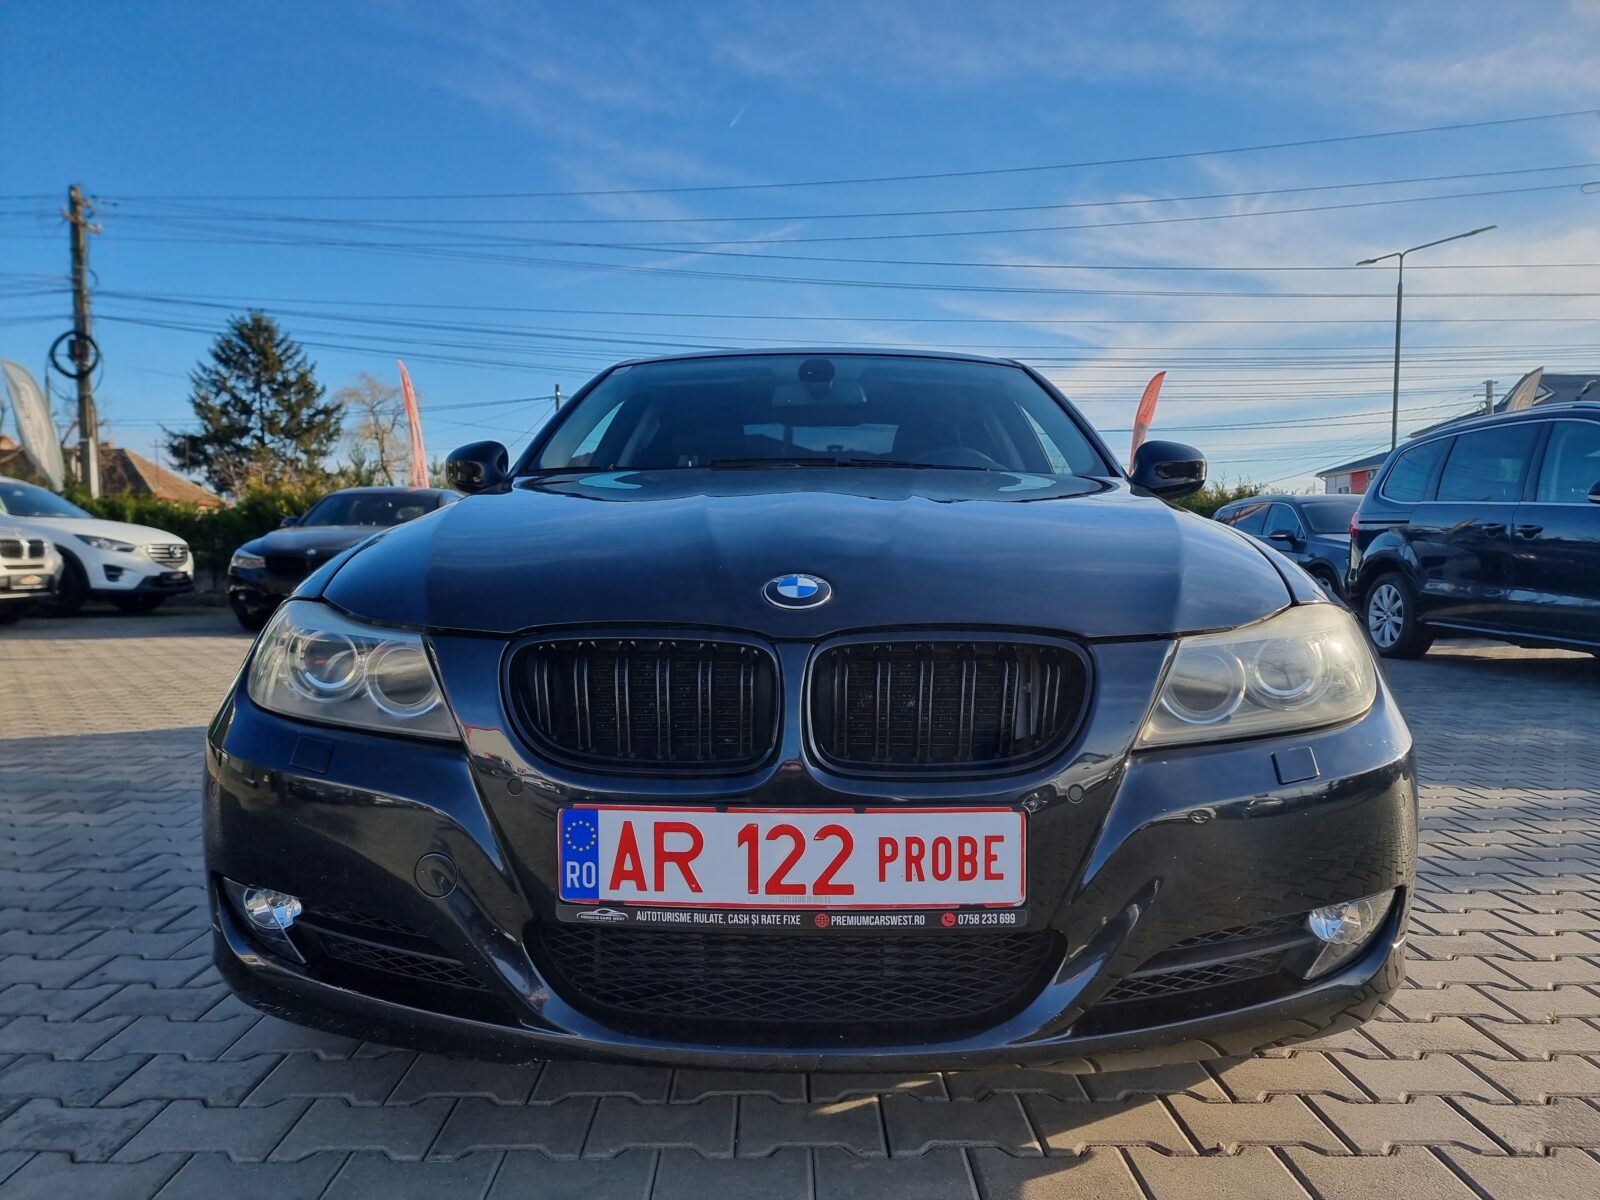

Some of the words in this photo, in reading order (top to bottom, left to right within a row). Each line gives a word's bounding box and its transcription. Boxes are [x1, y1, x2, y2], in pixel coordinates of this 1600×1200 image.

[608, 820, 705, 893] AR
[737, 822, 855, 896] 122
[878, 834, 1005, 882] PROBE
[566, 861, 596, 889] RO
[636, 910, 692, 923] AUTOTURISME
[694, 912, 726, 925] RULATE,
[728, 913, 749, 925] CASH
[761, 914, 781, 925] RATE
[783, 914, 801, 925] FIXE
[830, 914, 925, 926] PREMIUMCARSWEST.RO
[957, 914, 980, 925] 0758
[982, 914, 998, 924] 233
[999, 913, 1016, 923] 699
